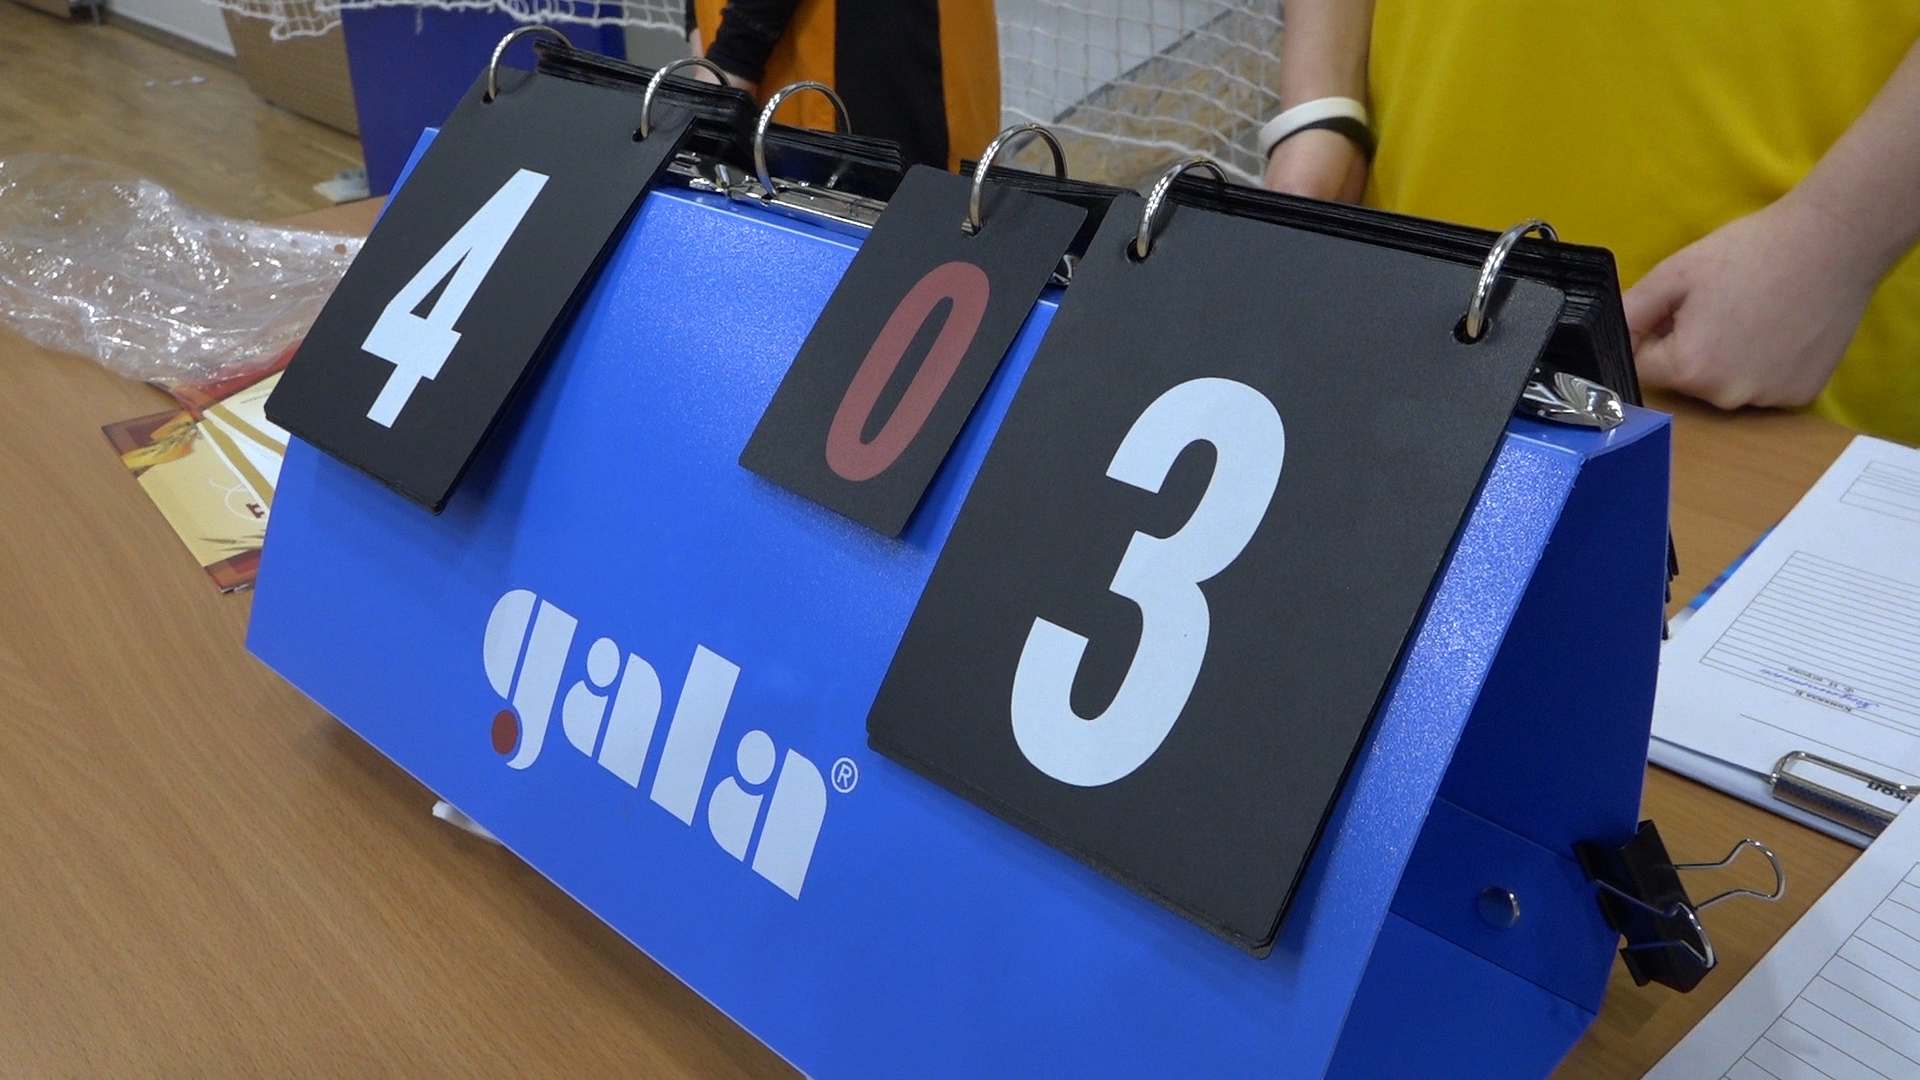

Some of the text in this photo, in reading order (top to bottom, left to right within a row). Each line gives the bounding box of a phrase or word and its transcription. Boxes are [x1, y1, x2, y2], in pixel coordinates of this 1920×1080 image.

[361, 169, 549, 428] 4
[828, 262, 989, 480] 0
[1011, 377, 1286, 787] 3
[482, 588, 828, 901] gala
